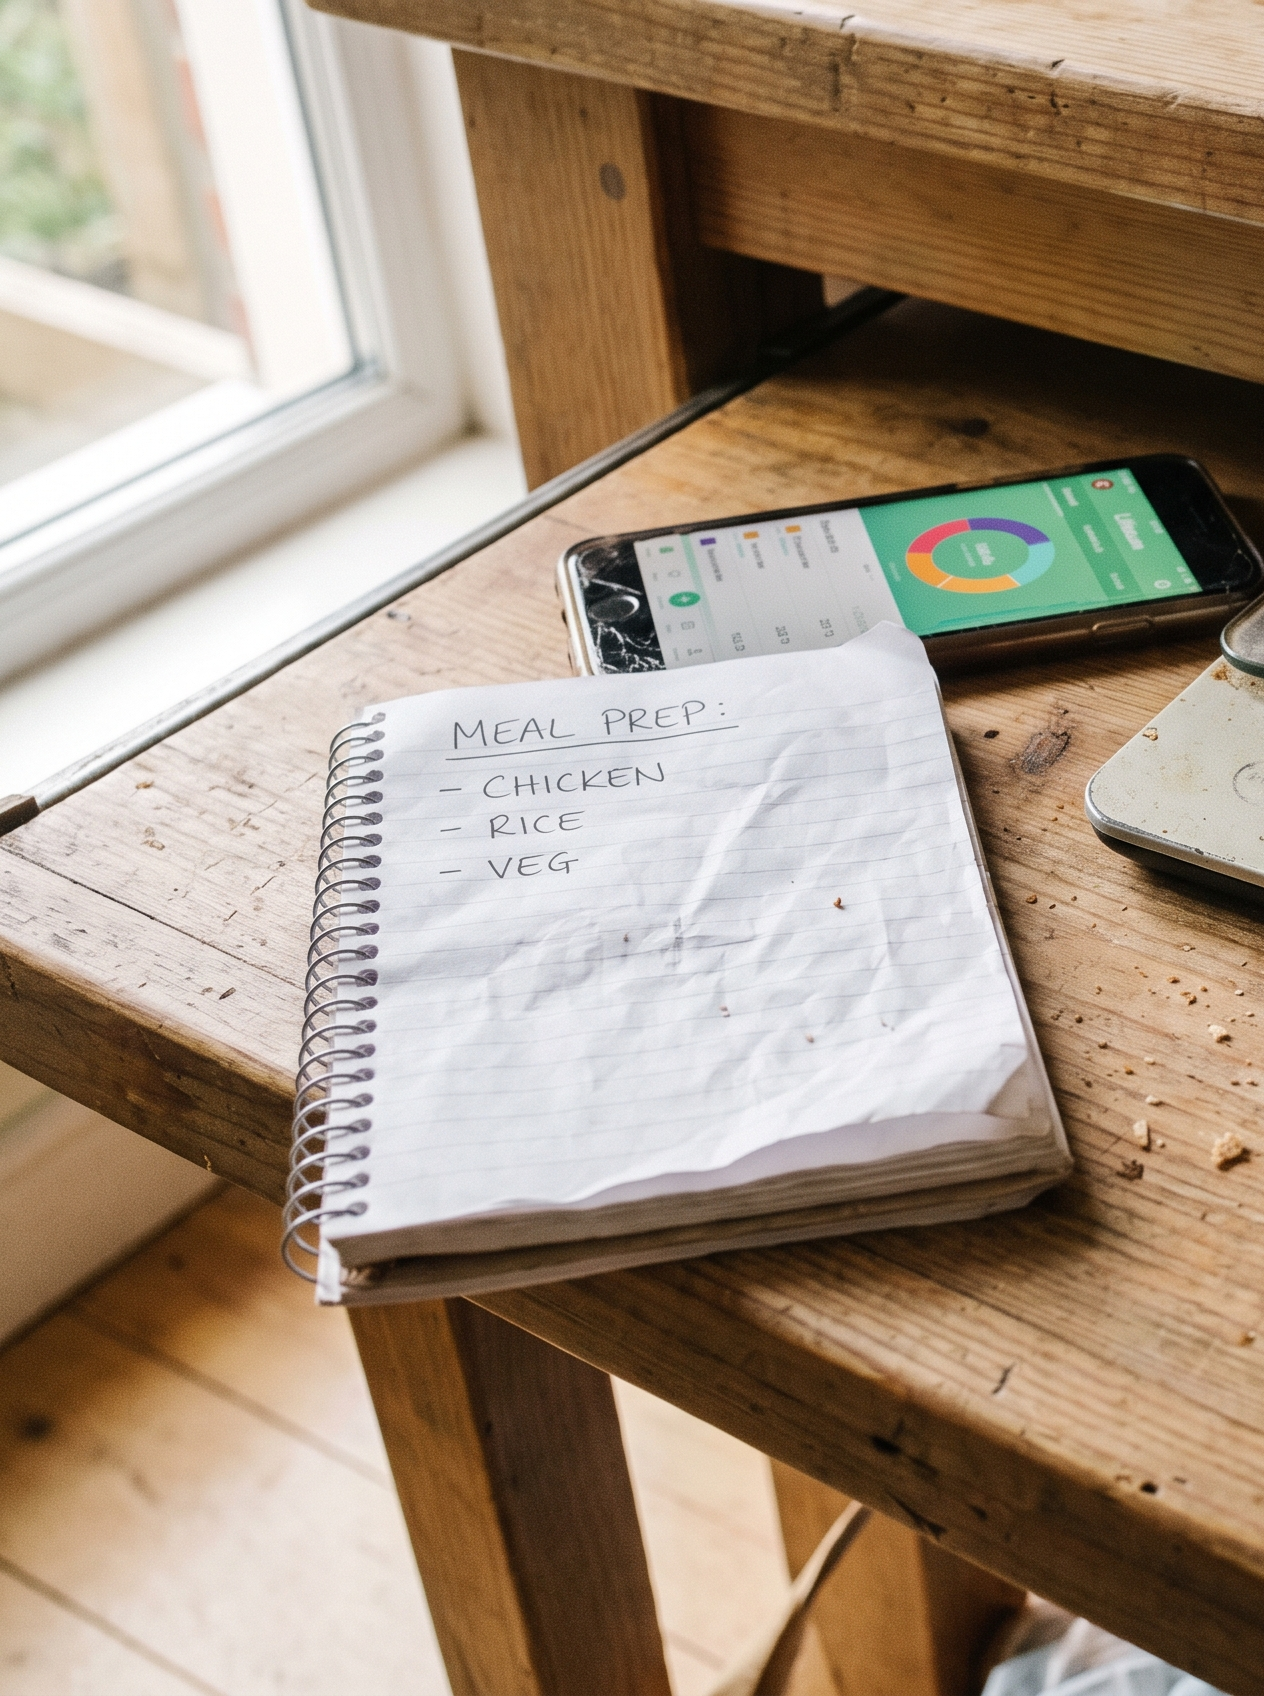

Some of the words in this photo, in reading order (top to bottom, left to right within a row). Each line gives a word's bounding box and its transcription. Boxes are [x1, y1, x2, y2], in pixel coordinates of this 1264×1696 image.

[453, 717, 575, 750] MEAL
[601, 699, 727, 736] PREP:
[482, 762, 666, 799] CHICKEN
[489, 810, 586, 839] RICE
[488, 851, 579, 880] VEG
